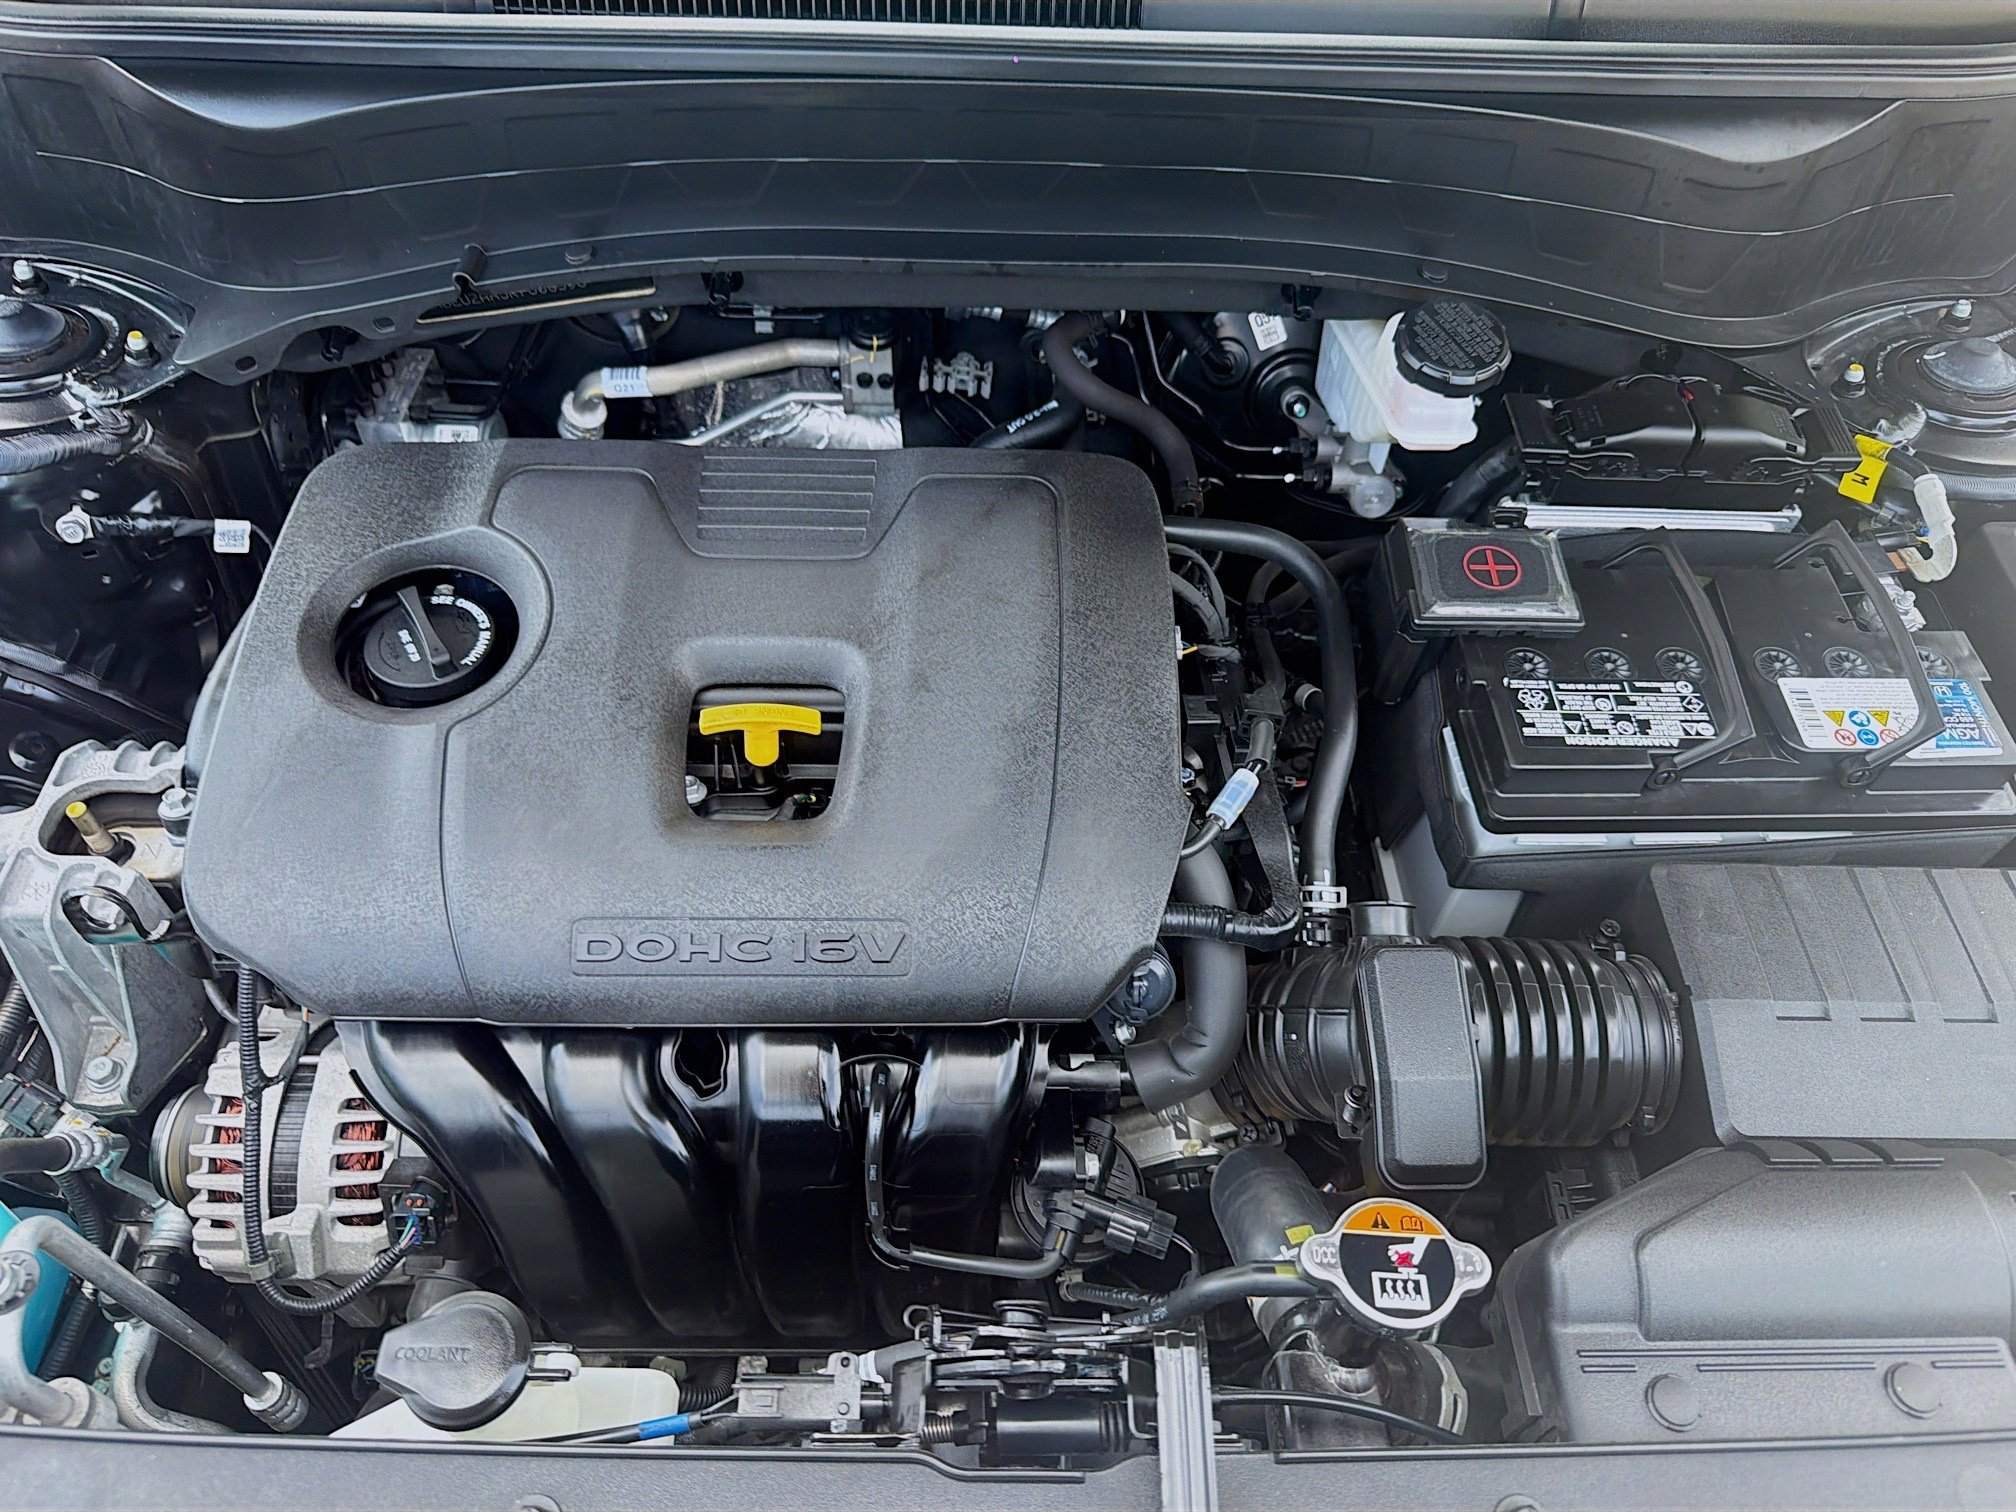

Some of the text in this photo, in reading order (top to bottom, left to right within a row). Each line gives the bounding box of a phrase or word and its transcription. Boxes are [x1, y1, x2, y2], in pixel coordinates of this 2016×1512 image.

[431, 595, 455, 605] SEE
[460, 631, 491, 666] MANUAL
[1943, 728, 1980, 740] AGM
[575, 932, 907, 964] DOHC 16V
[1455, 1251, 1482, 1273] 1.1
[394, 1345, 471, 1363] COOLANT
